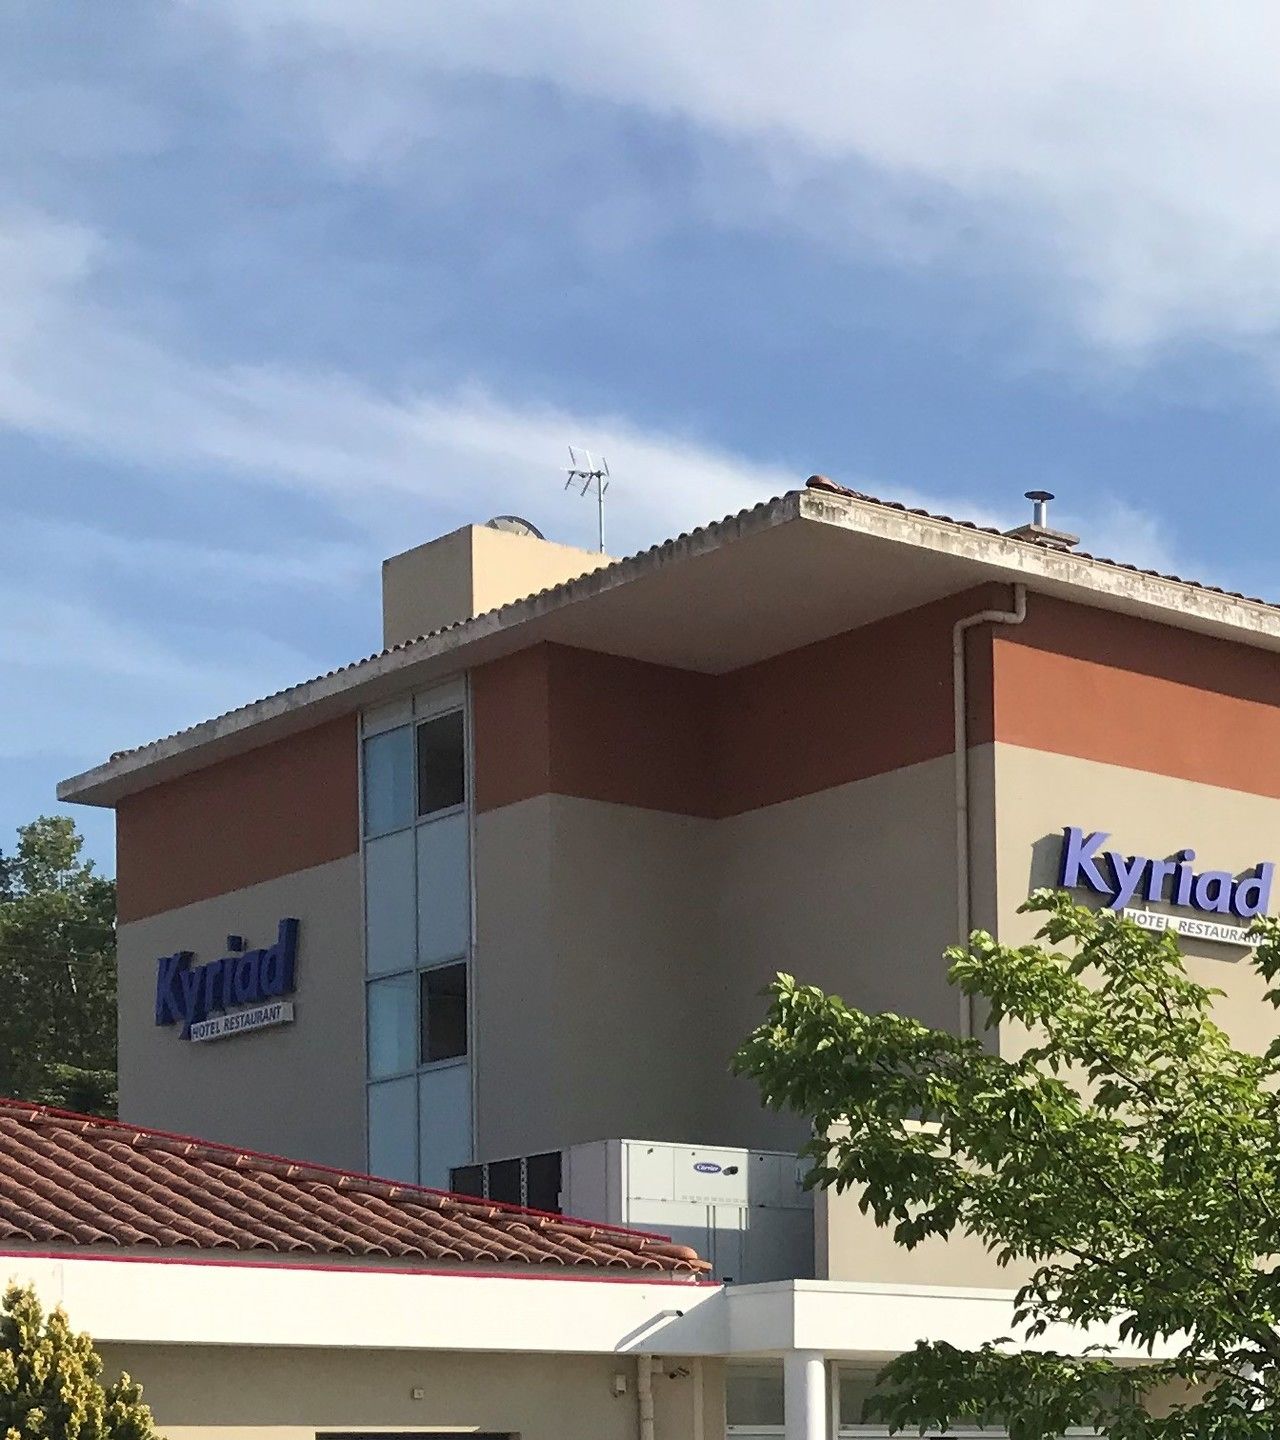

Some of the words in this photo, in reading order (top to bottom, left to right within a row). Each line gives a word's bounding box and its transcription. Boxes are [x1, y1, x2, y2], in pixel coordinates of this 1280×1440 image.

[1061, 827, 1276, 917] Kyriad
[155, 918, 299, 1040] Kyriad
[192, 1021, 221, 1039] HOTEL
[223, 1005, 281, 1031] RESTAURANT
